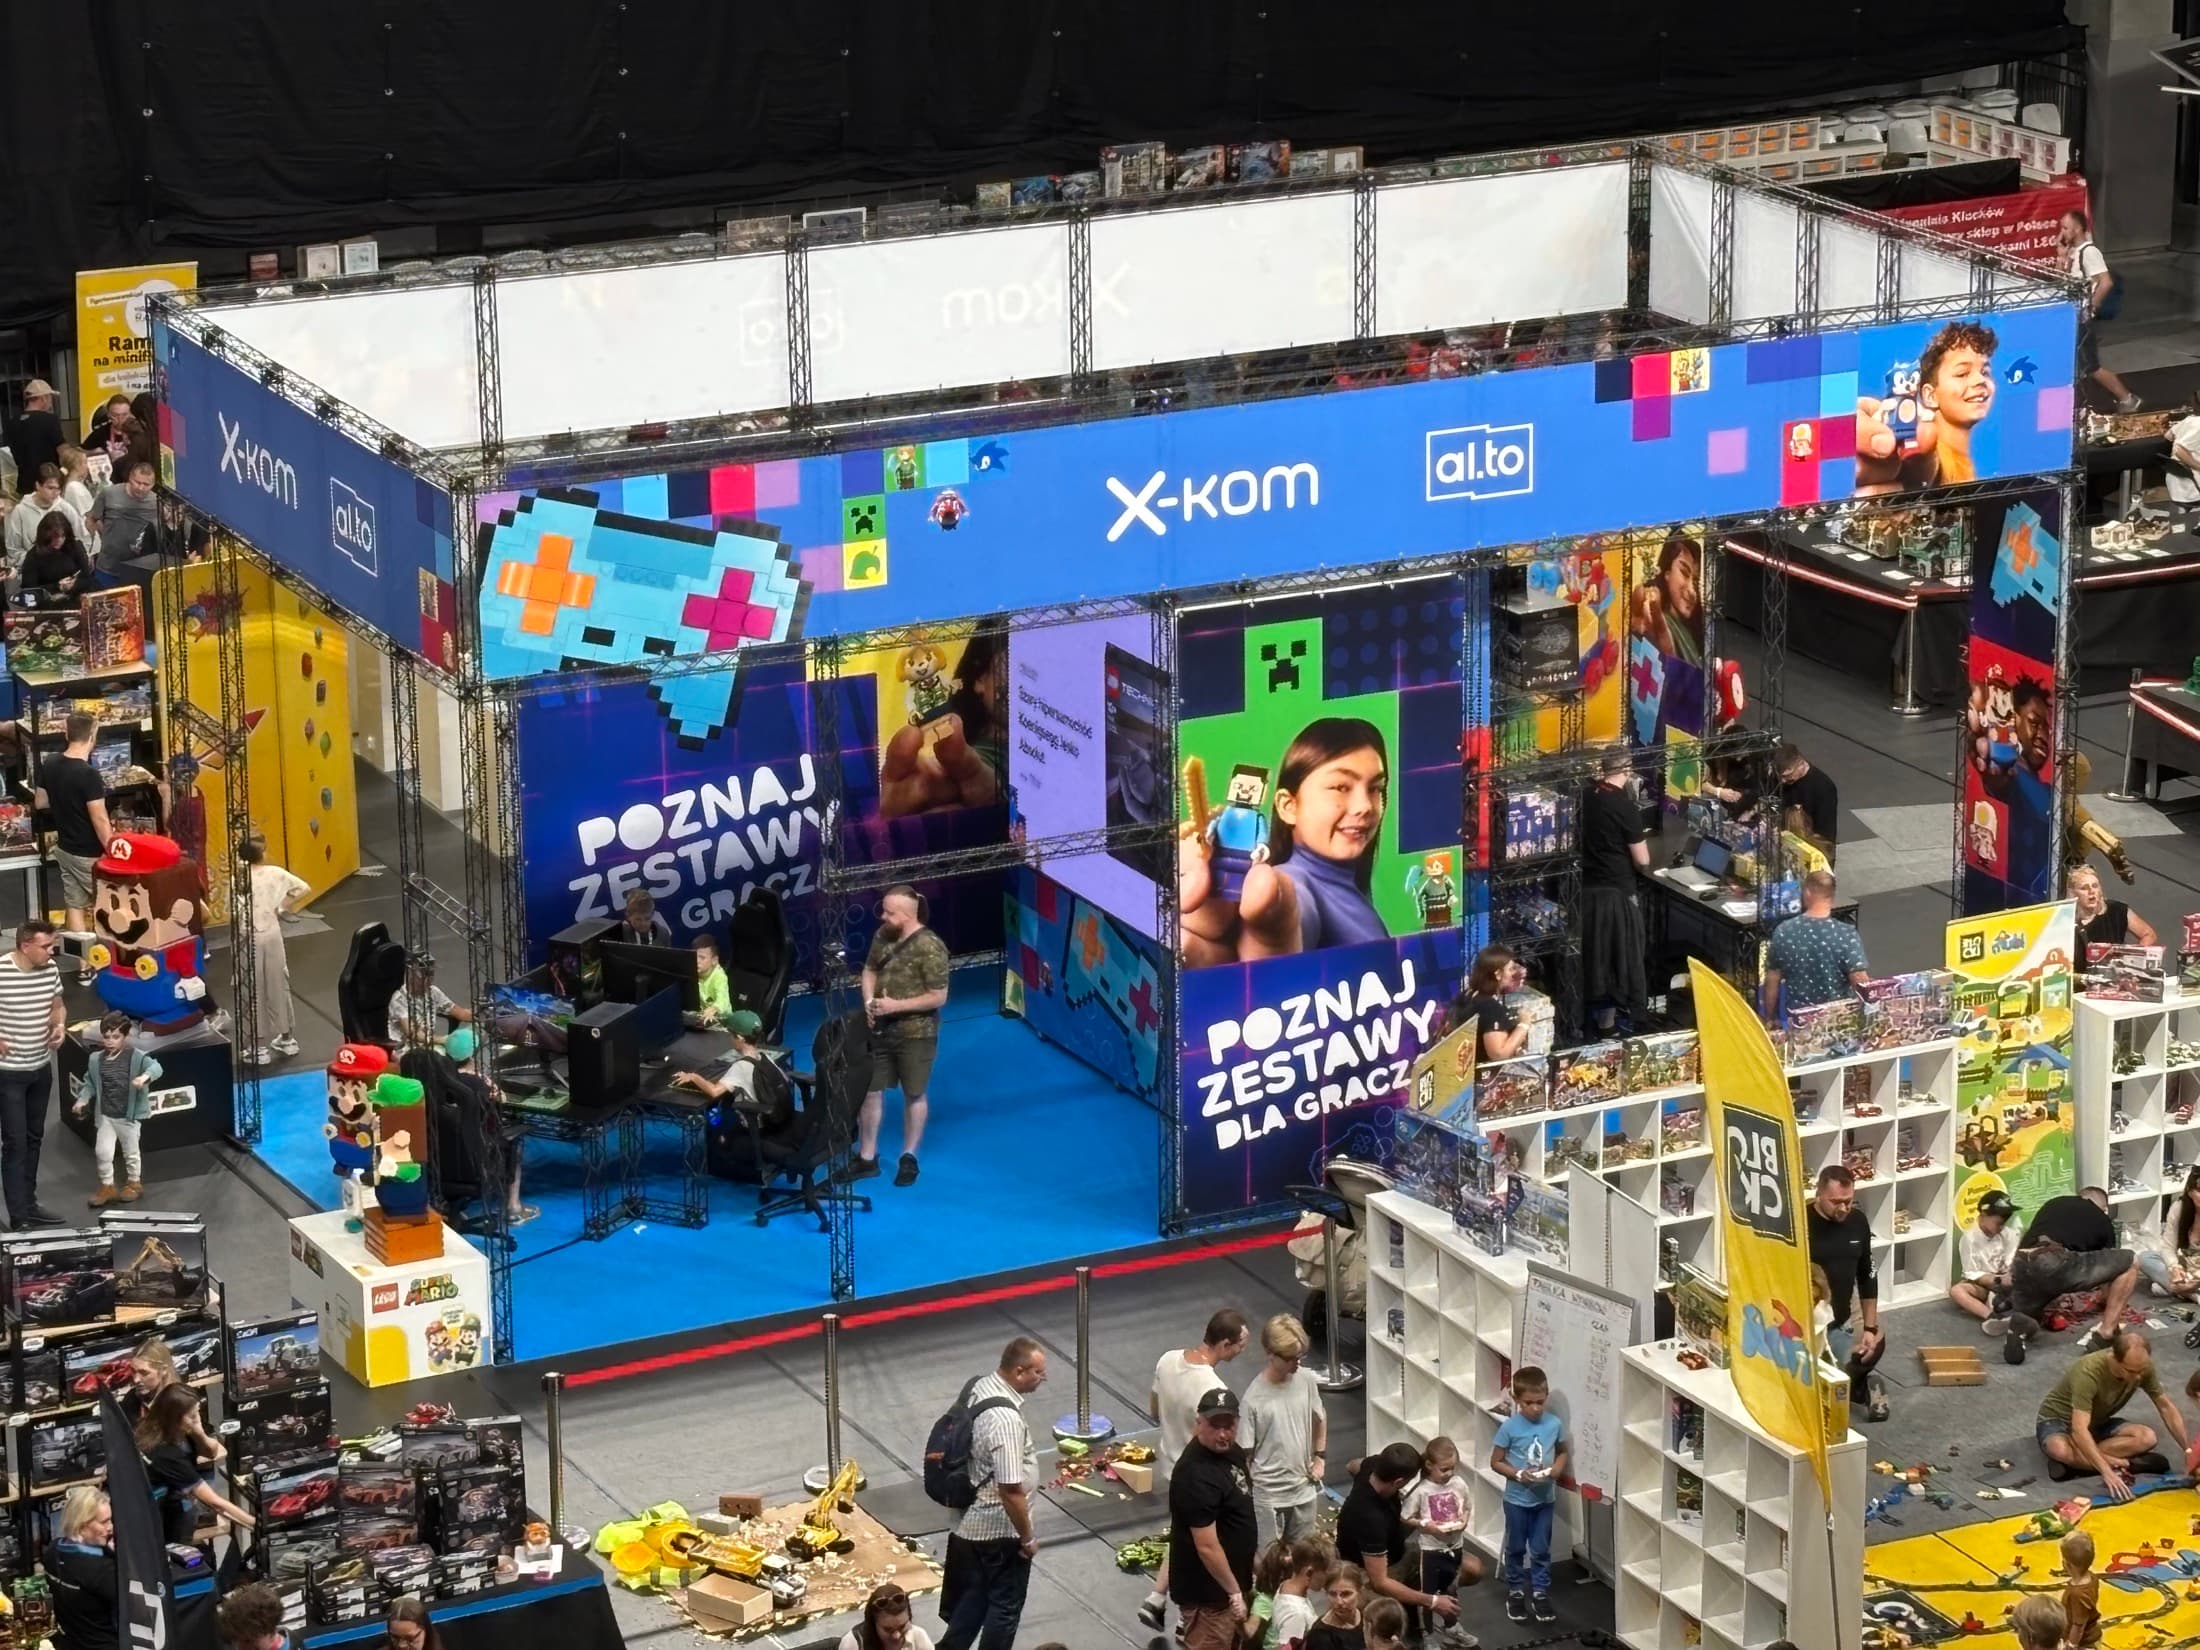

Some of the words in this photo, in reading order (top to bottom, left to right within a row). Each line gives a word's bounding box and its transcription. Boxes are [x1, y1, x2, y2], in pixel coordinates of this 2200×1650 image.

[1966, 226, 2001, 240] sklep
[93, 355, 110, 368] na
[108, 335, 152, 352] Ram
[1435, 438, 1525, 484] al.to
[335, 503, 373, 553] al.to
[577, 753, 817, 867] POZNAJ
[568, 798, 841, 923] ZESTAWY
[1207, 959, 1416, 1065] POZNAJ
[1197, 1000, 1436, 1118] ZESTAWY
[1216, 1104, 1287, 1150] DLA
[374, 1291, 398, 1306] LEGO
[404, 1283, 459, 1307] MARIO
[410, 1273, 453, 1291] SUPER
